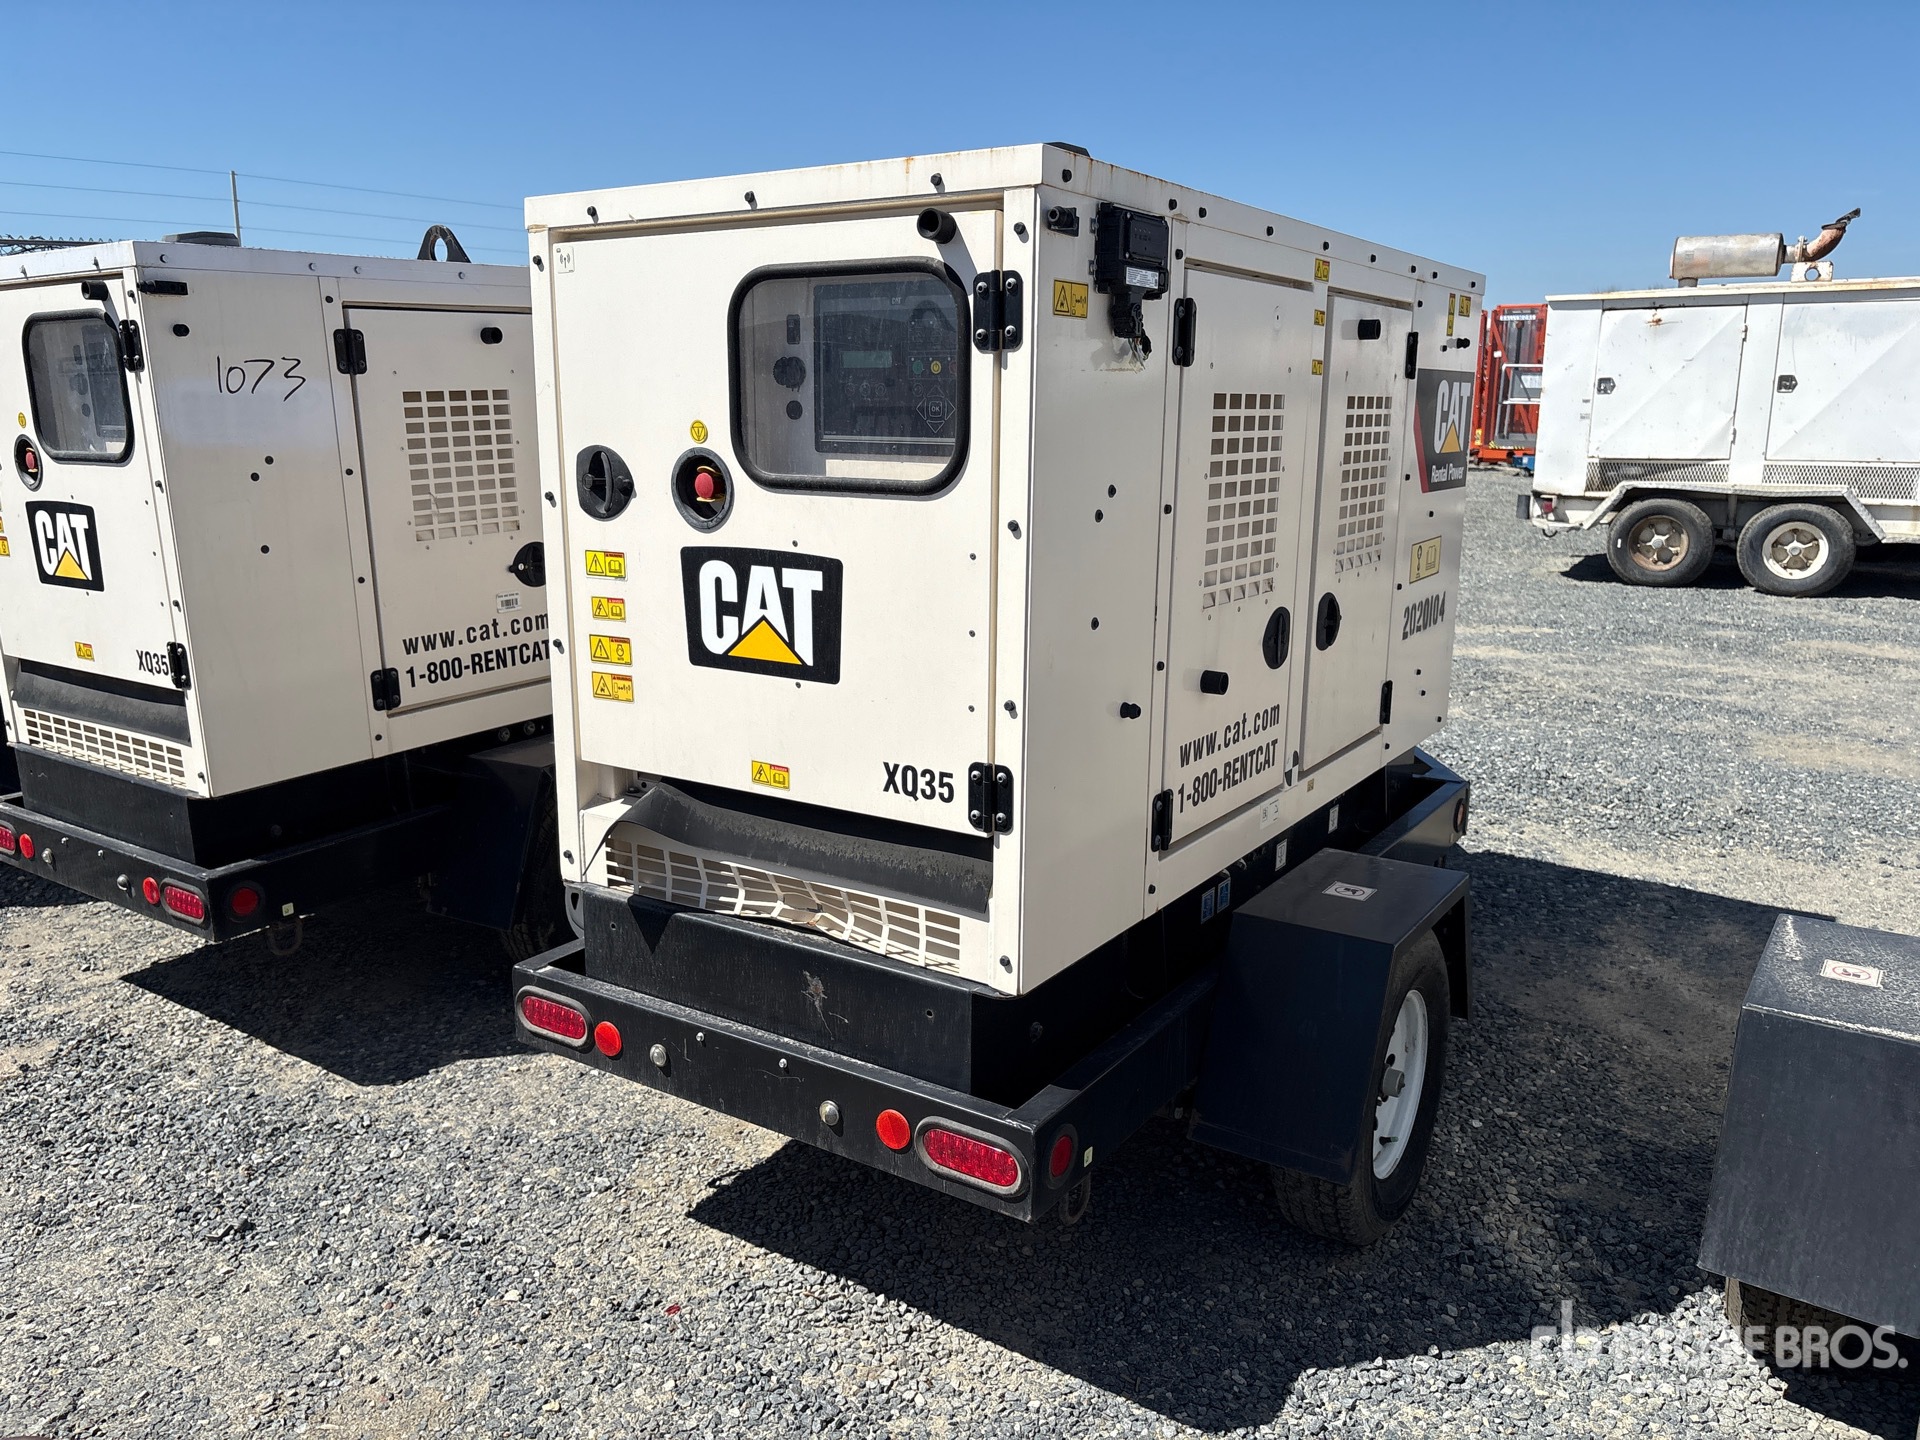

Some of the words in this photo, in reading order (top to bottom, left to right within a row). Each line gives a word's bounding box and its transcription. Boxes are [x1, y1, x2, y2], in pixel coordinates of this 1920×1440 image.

[217, 355, 306, 402] 1073
[1434, 380, 1471, 453] CAT
[1430, 464, 1449, 483] Rental
[1448, 463, 1464, 481] Power
[35, 510, 92, 581] CAT
[402, 613, 549, 655] www.cat.com
[699, 560, 823, 666] CAT
[136, 650, 170, 676] XQ35
[406, 640, 550, 688] 1-800-RENTCAT
[1180, 704, 1280, 768] www.cat.com
[883, 761, 954, 803] XQ35
[1178, 738, 1278, 813] 1-800-RENTCAT
